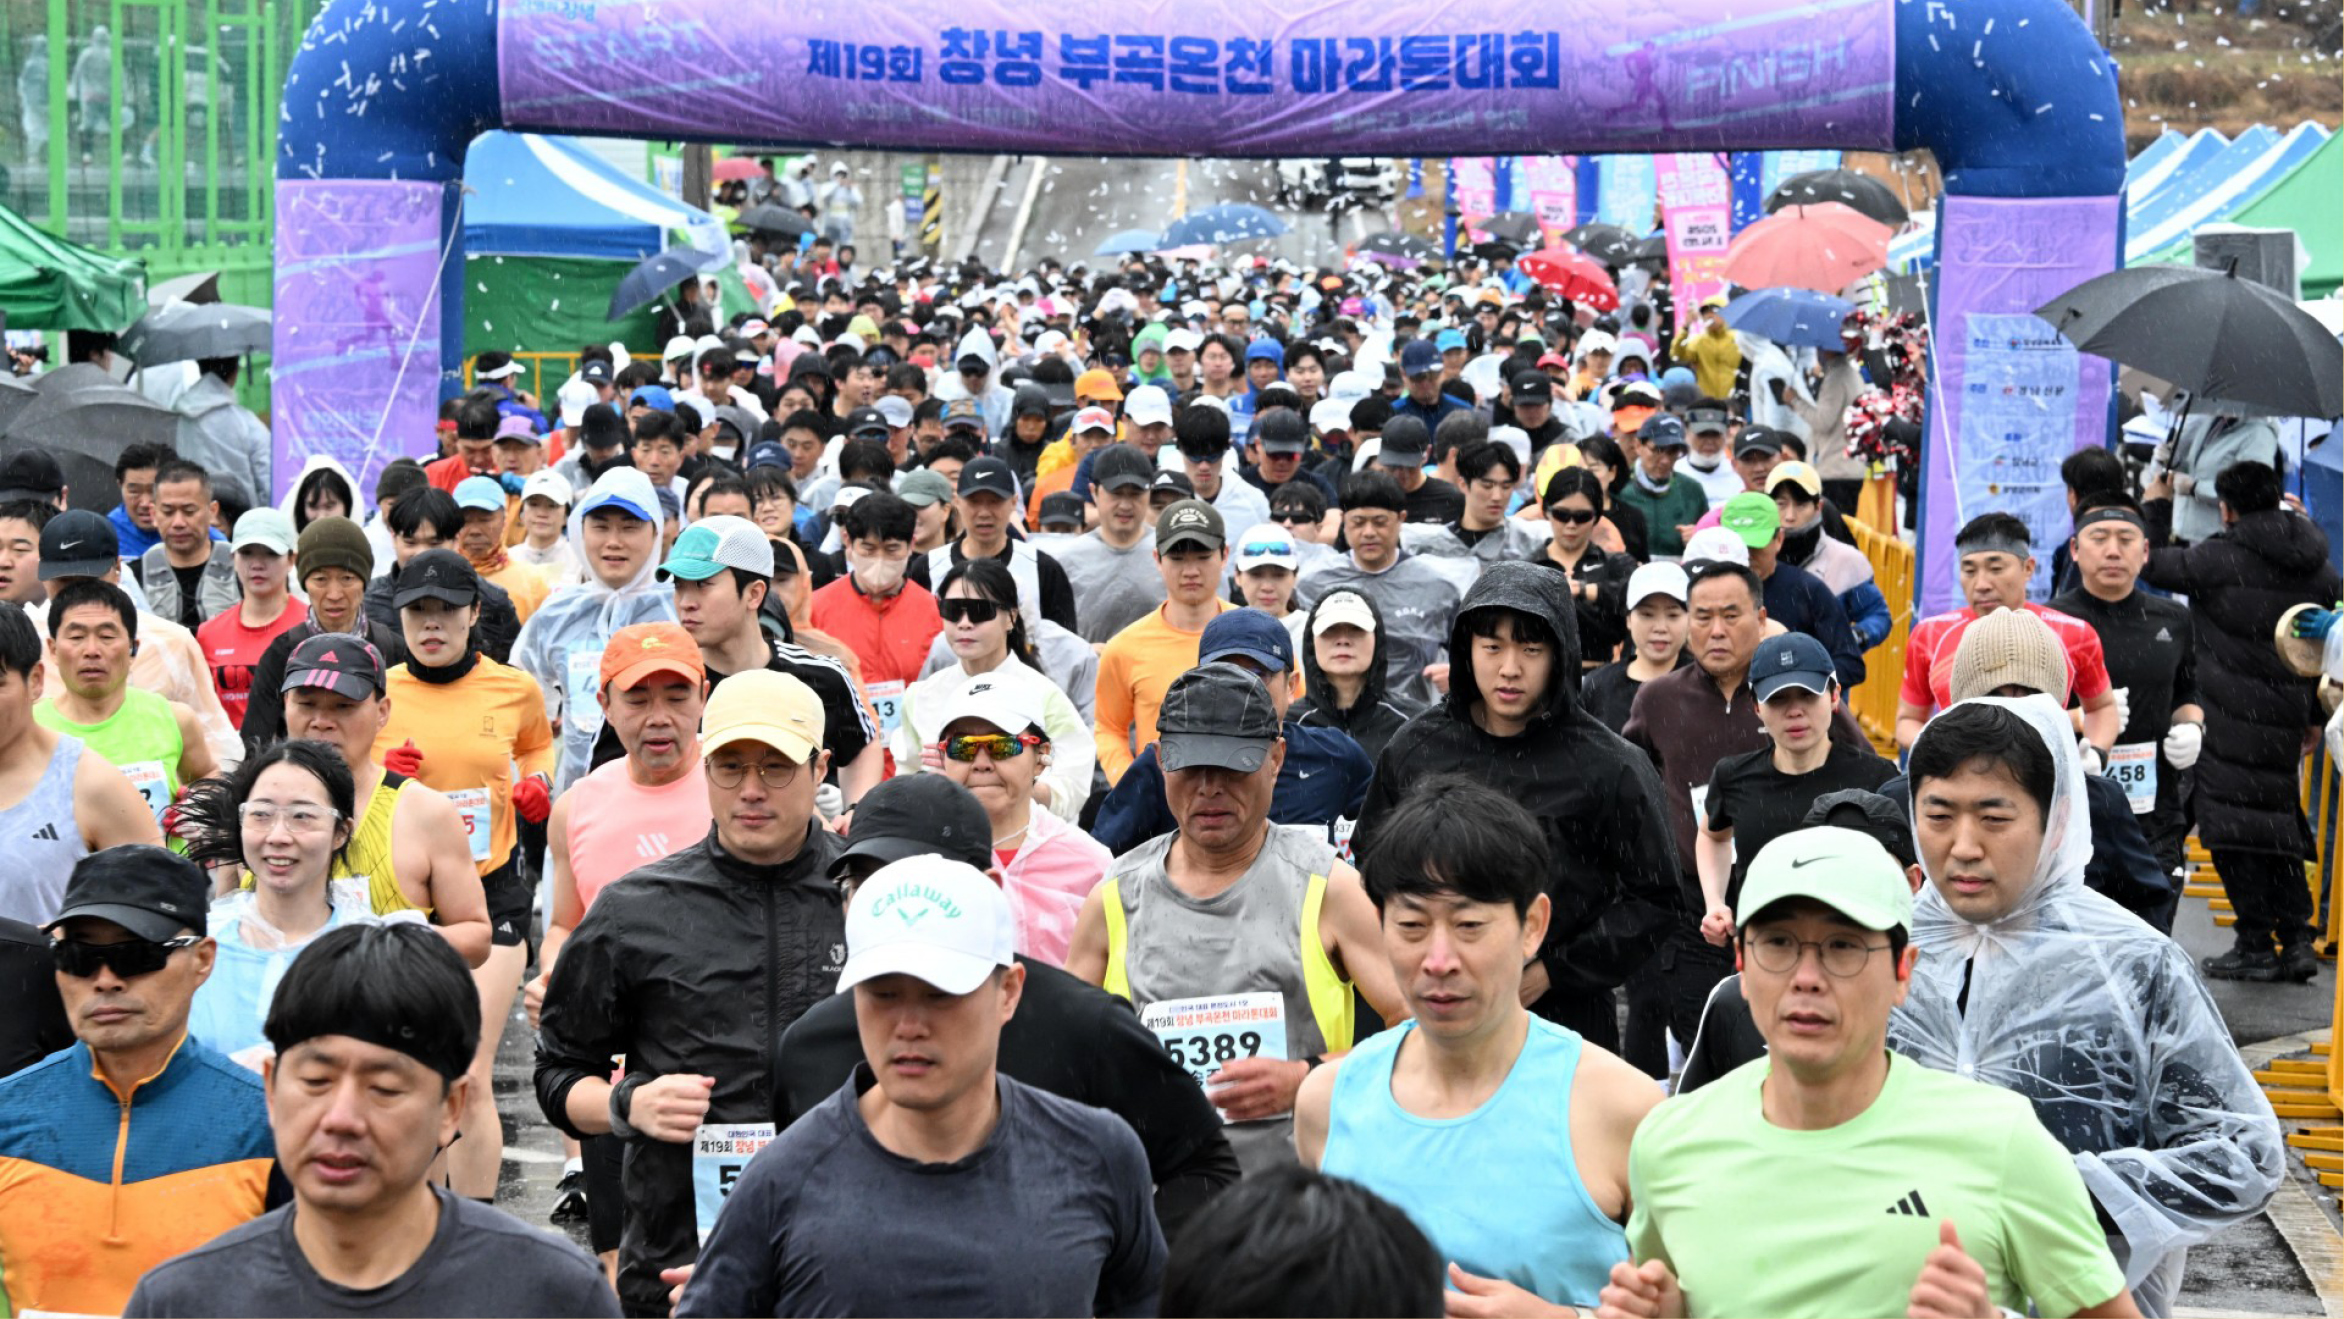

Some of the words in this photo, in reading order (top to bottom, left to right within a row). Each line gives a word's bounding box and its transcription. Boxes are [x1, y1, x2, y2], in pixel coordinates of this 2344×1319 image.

[534, 21, 703, 68] START
[807, 38, 922, 83] 제19회
[939, 27, 1043, 86] 창녕
[1060, 34, 1274, 95] 부곡온천
[1291, 30, 1560, 95] 마라톤대회
[1686, 35, 1847, 103] FINISH
[872, 882, 962, 918] Callaway
[1147, 1016, 1174, 1028] 제19회
[1176, 1013, 1194, 1027] 창녕
[1196, 1009, 1230, 1025] 부곡온천
[1232, 1006, 1278, 1021] 마라톤대회
[1164, 1031, 1262, 1068] 5389
[701, 1140, 733, 1153] 제19회
[735, 1139, 755, 1154] 창녕
[727, 1130, 756, 1138] 대한민국
[757, 1129, 772, 1137] 대표
